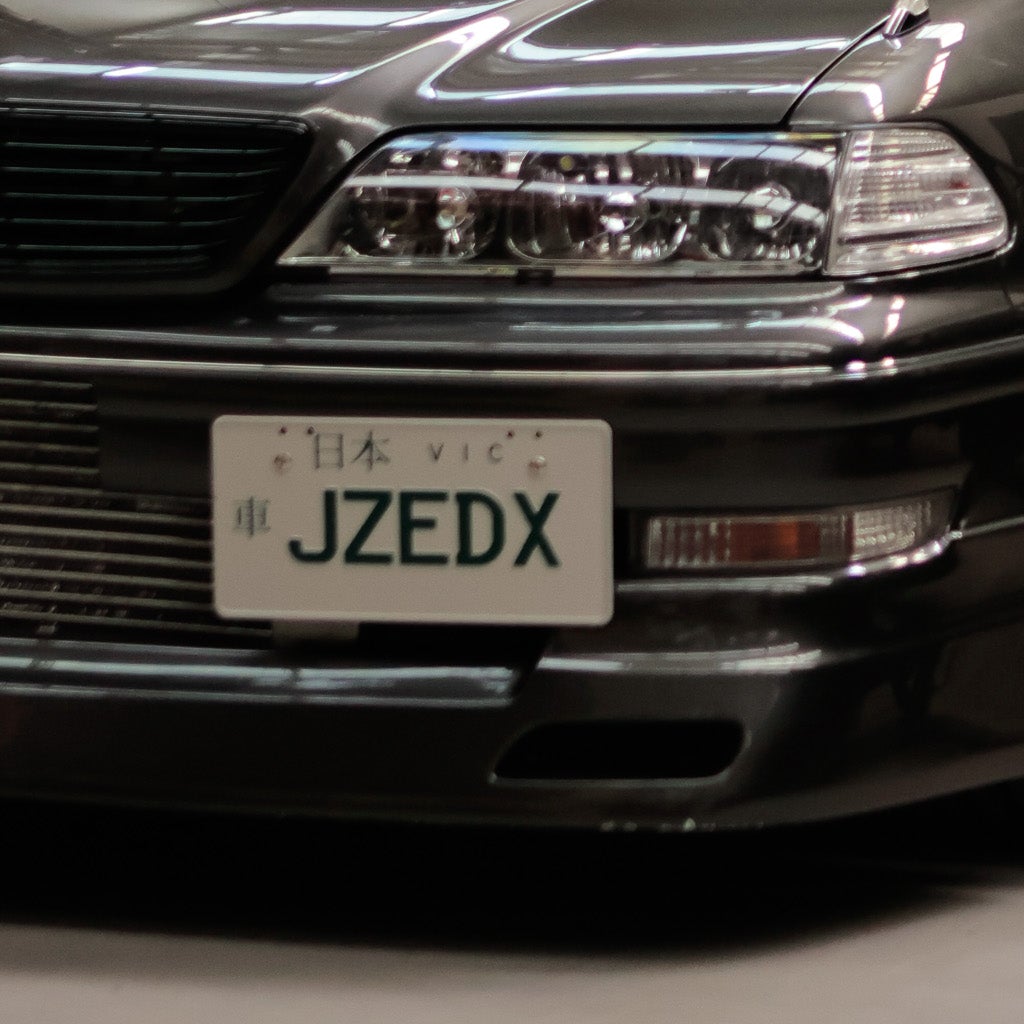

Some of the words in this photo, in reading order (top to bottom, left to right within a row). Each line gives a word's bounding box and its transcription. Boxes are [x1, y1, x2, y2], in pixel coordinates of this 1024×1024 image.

[314, 430, 391, 470] 日本
[429, 442, 504, 463] VIC
[288, 489, 561, 569] JZEDX
